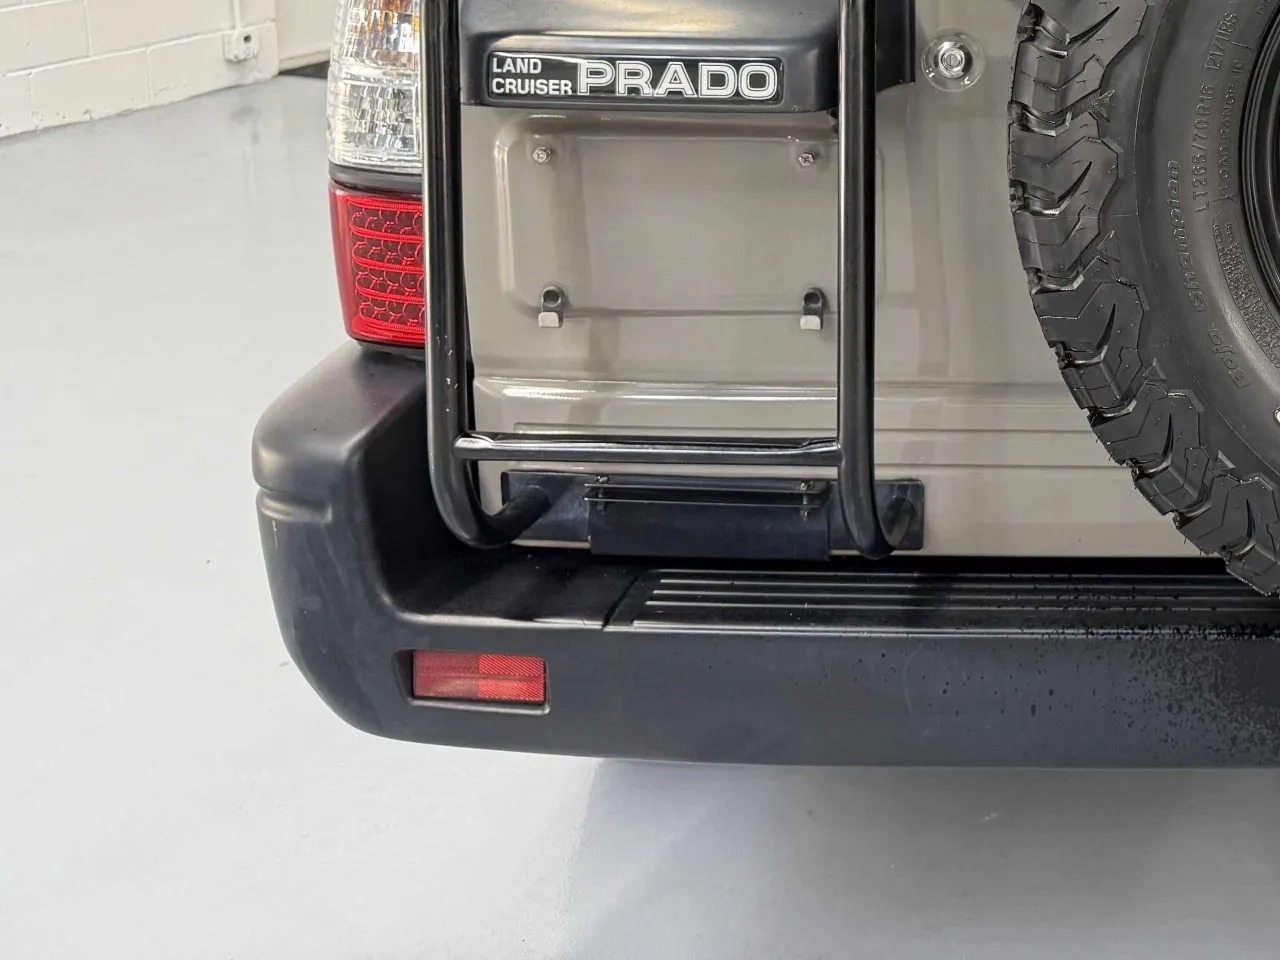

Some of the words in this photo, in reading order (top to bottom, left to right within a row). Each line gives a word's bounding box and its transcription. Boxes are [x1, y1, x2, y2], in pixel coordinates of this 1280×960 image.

[492, 58, 542, 74] LAND
[577, 60, 778, 100] PRADO
[492, 78, 573, 95] CRUISER
[1168, 160, 1207, 312] Champion
